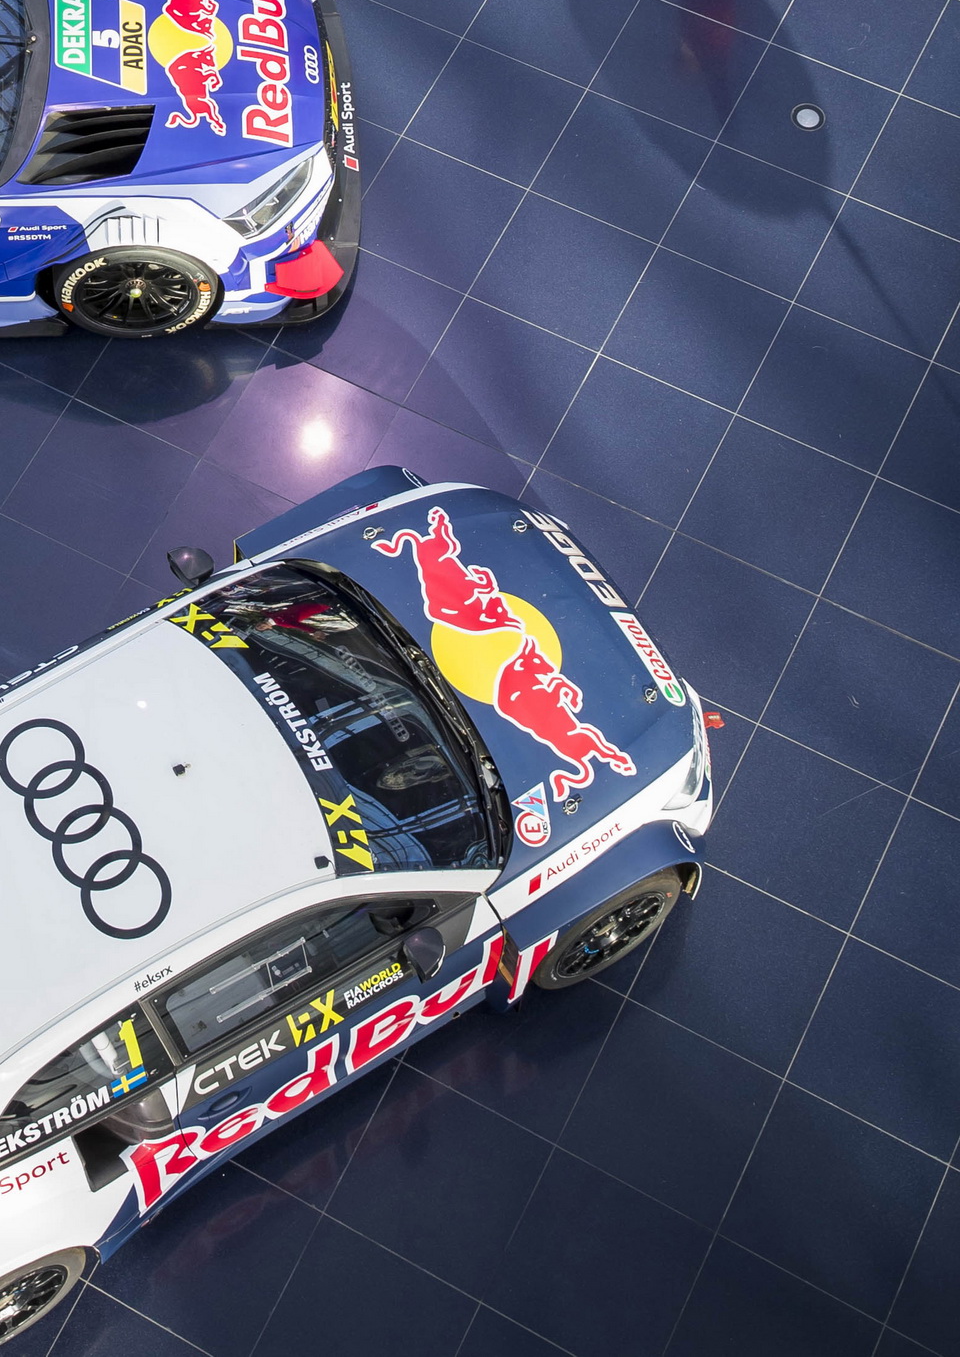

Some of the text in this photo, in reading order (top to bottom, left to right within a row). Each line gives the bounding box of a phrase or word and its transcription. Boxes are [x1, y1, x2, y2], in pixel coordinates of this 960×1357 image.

[92, 29, 120, 49] 5
[123, 21, 144, 70] ADAC
[238, 46, 292, 146] Red
[341, 82, 356, 154] Audi Sport
[522, 509, 628, 608] EDGE
[619, 618, 672, 685] Castrol
[253, 672, 333, 772] EKSTRÖM
[546, 821, 623, 881] Audi Sport
[134, 964, 173, 992] #eksrx
[346, 970, 404, 1009] RALLYCROSS
[117, 1017, 145, 1069] 1
[120, 932, 558, 1216] Red Bull
[194, 1030, 286, 1095] CTEK
